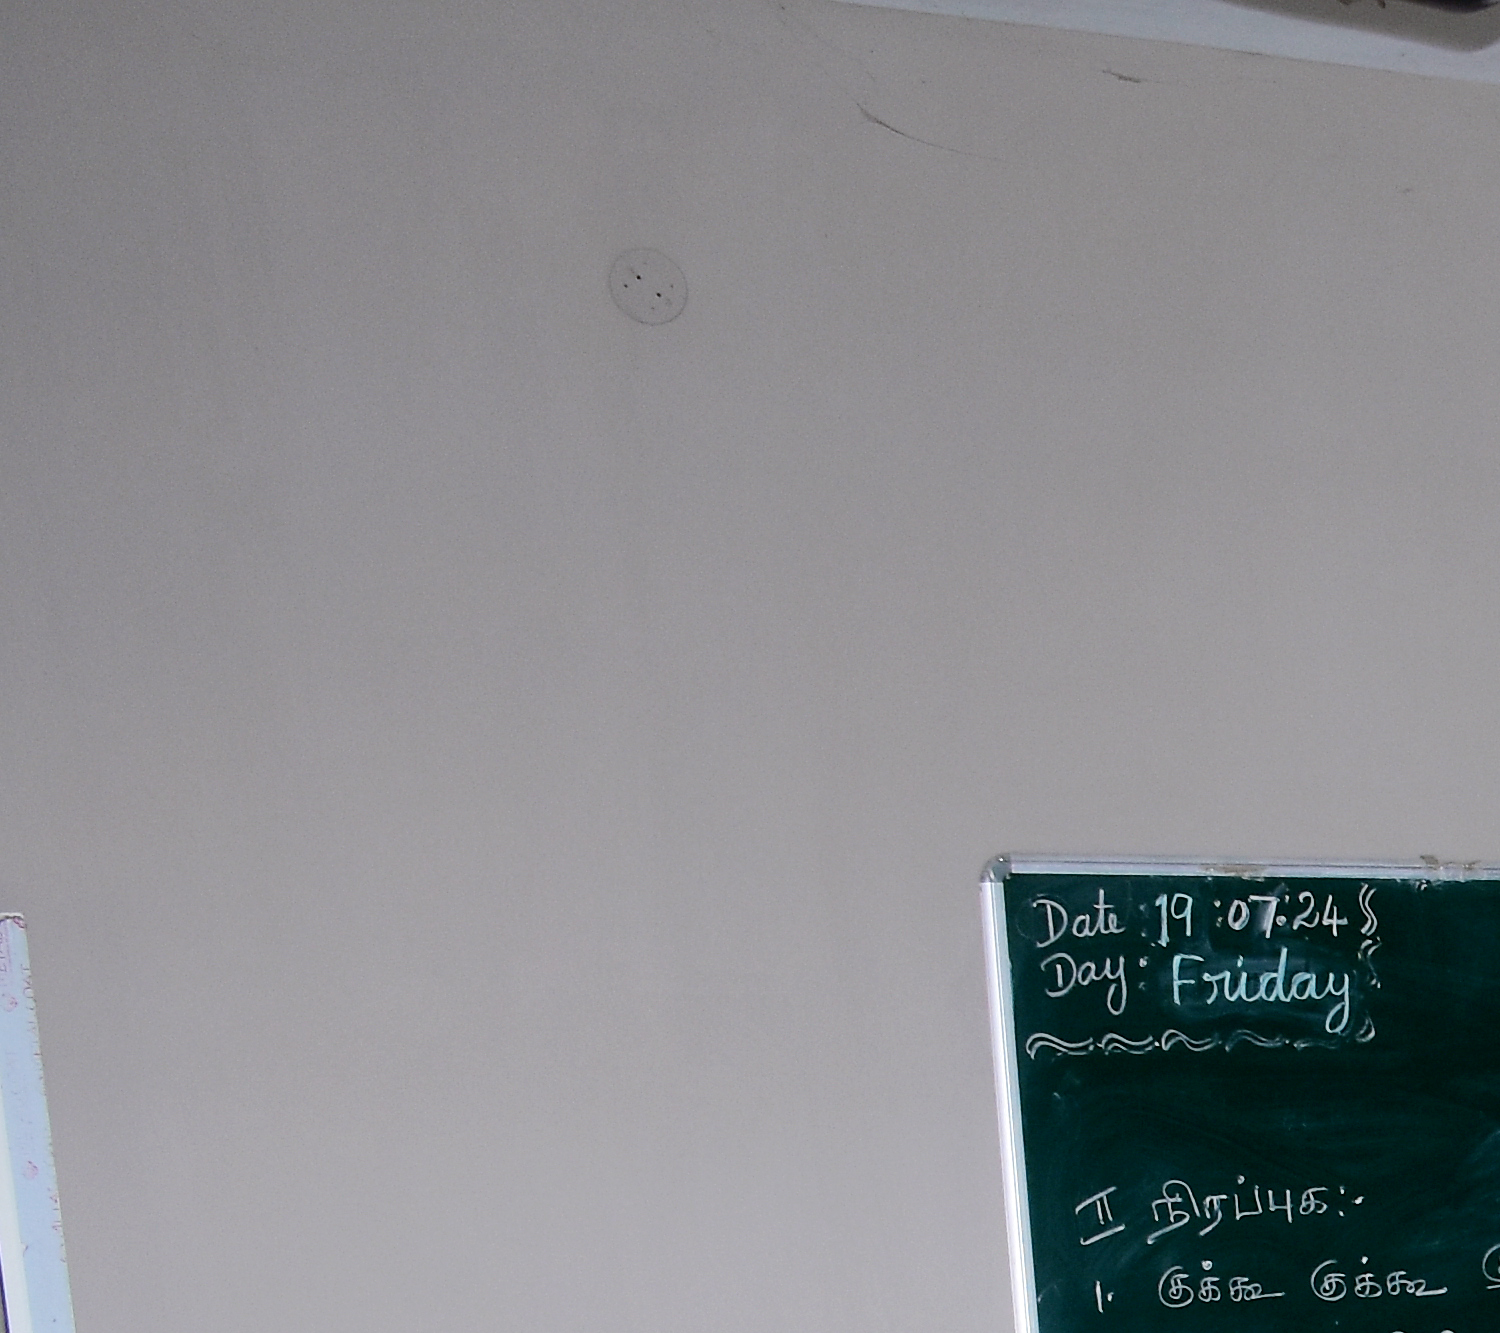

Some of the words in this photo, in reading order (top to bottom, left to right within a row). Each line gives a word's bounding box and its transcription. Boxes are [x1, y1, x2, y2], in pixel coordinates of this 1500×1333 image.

[1172, 947, 1350, 1034] Friday
[1158, 1260, 1285, 1307] குக்கூ
[1310, 1256, 1448, 1301] குக்கூ
